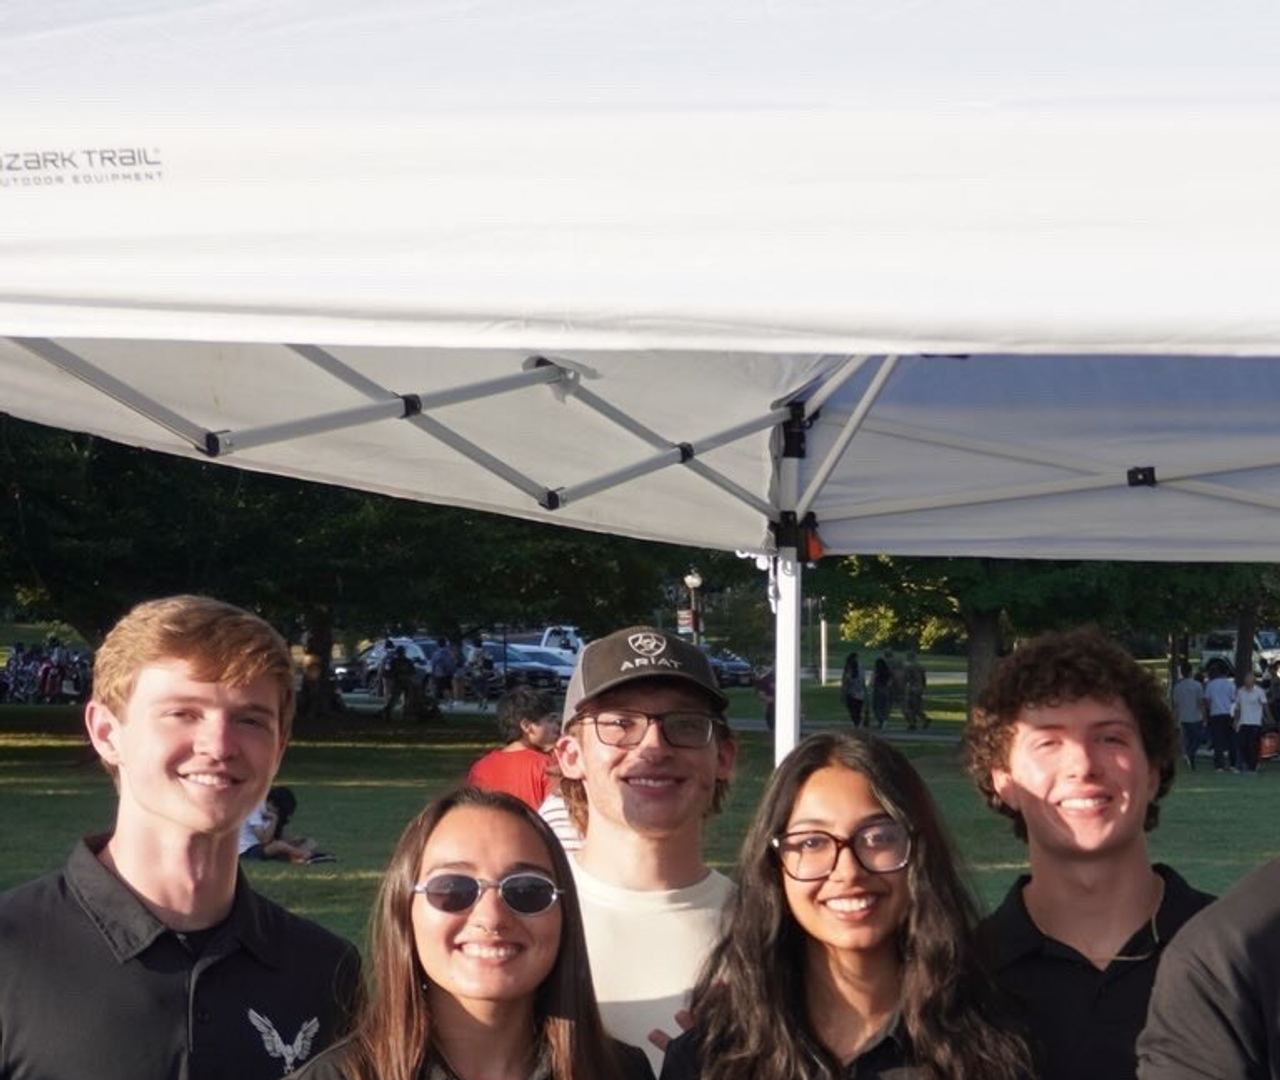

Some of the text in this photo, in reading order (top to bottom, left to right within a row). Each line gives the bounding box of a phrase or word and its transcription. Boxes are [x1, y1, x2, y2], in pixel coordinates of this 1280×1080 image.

[0, 171, 163, 188] UTDOOR EQUIPMENT
[620, 656, 682, 672] ARIAT
